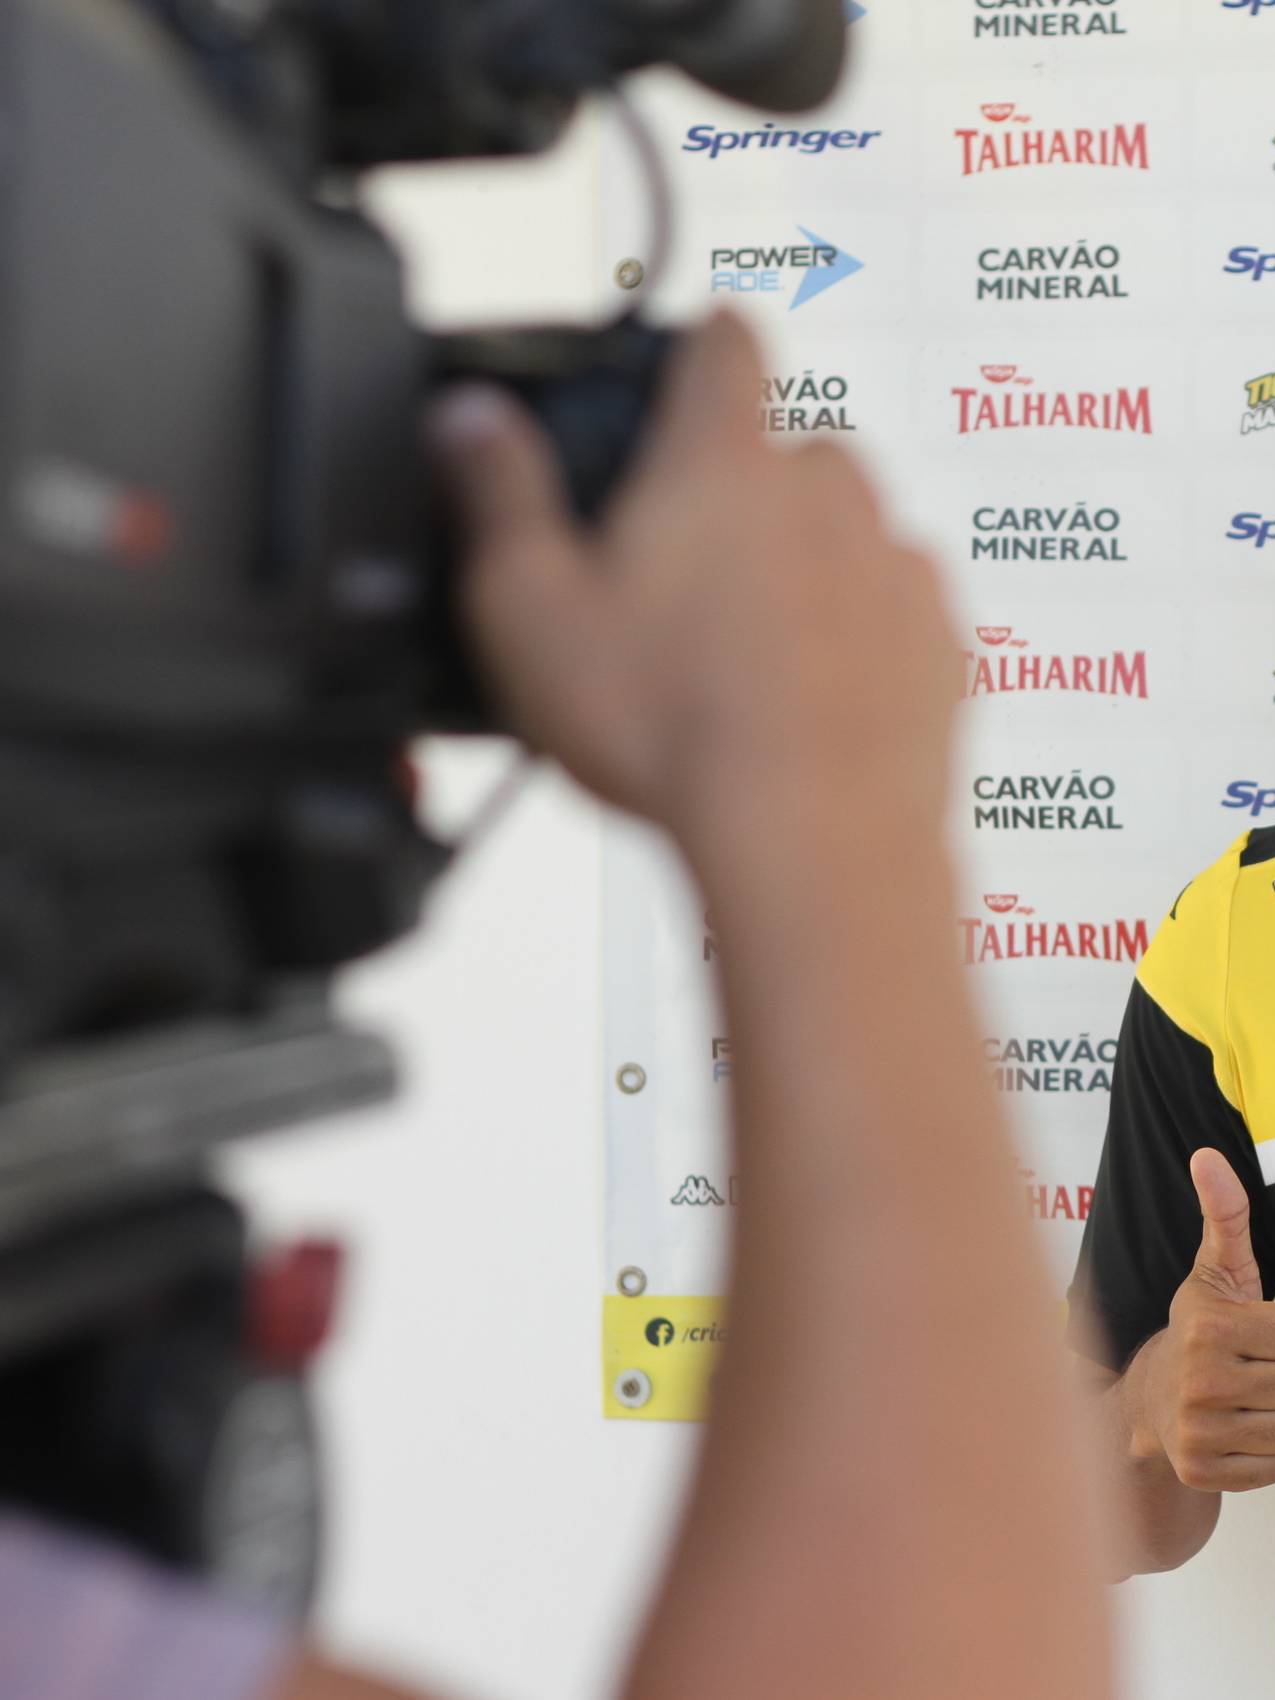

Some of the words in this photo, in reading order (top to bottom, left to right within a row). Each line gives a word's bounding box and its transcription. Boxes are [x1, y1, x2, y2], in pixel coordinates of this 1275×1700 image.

[973, 13, 1127, 37] MINERAL
[682, 123, 881, 159] Springer
[954, 123, 1149, 176] TALHARIM
[711, 245, 839, 270] POWER
[978, 239, 1120, 272] CARVÃO
[977, 275, 1129, 300] MINERAL
[758, 370, 848, 402] RVÃO
[760, 407, 856, 432] ERAL
[951, 387, 1153, 435] TALHARIM
[973, 501, 1120, 532] CARVÃO
[972, 537, 1127, 562] MINERAL
[973, 768, 1115, 800] CARVÃO
[974, 806, 1123, 830] MINERAL
[957, 918, 1149, 964] TALHARIM
[991, 1068, 1113, 1092] INERA
